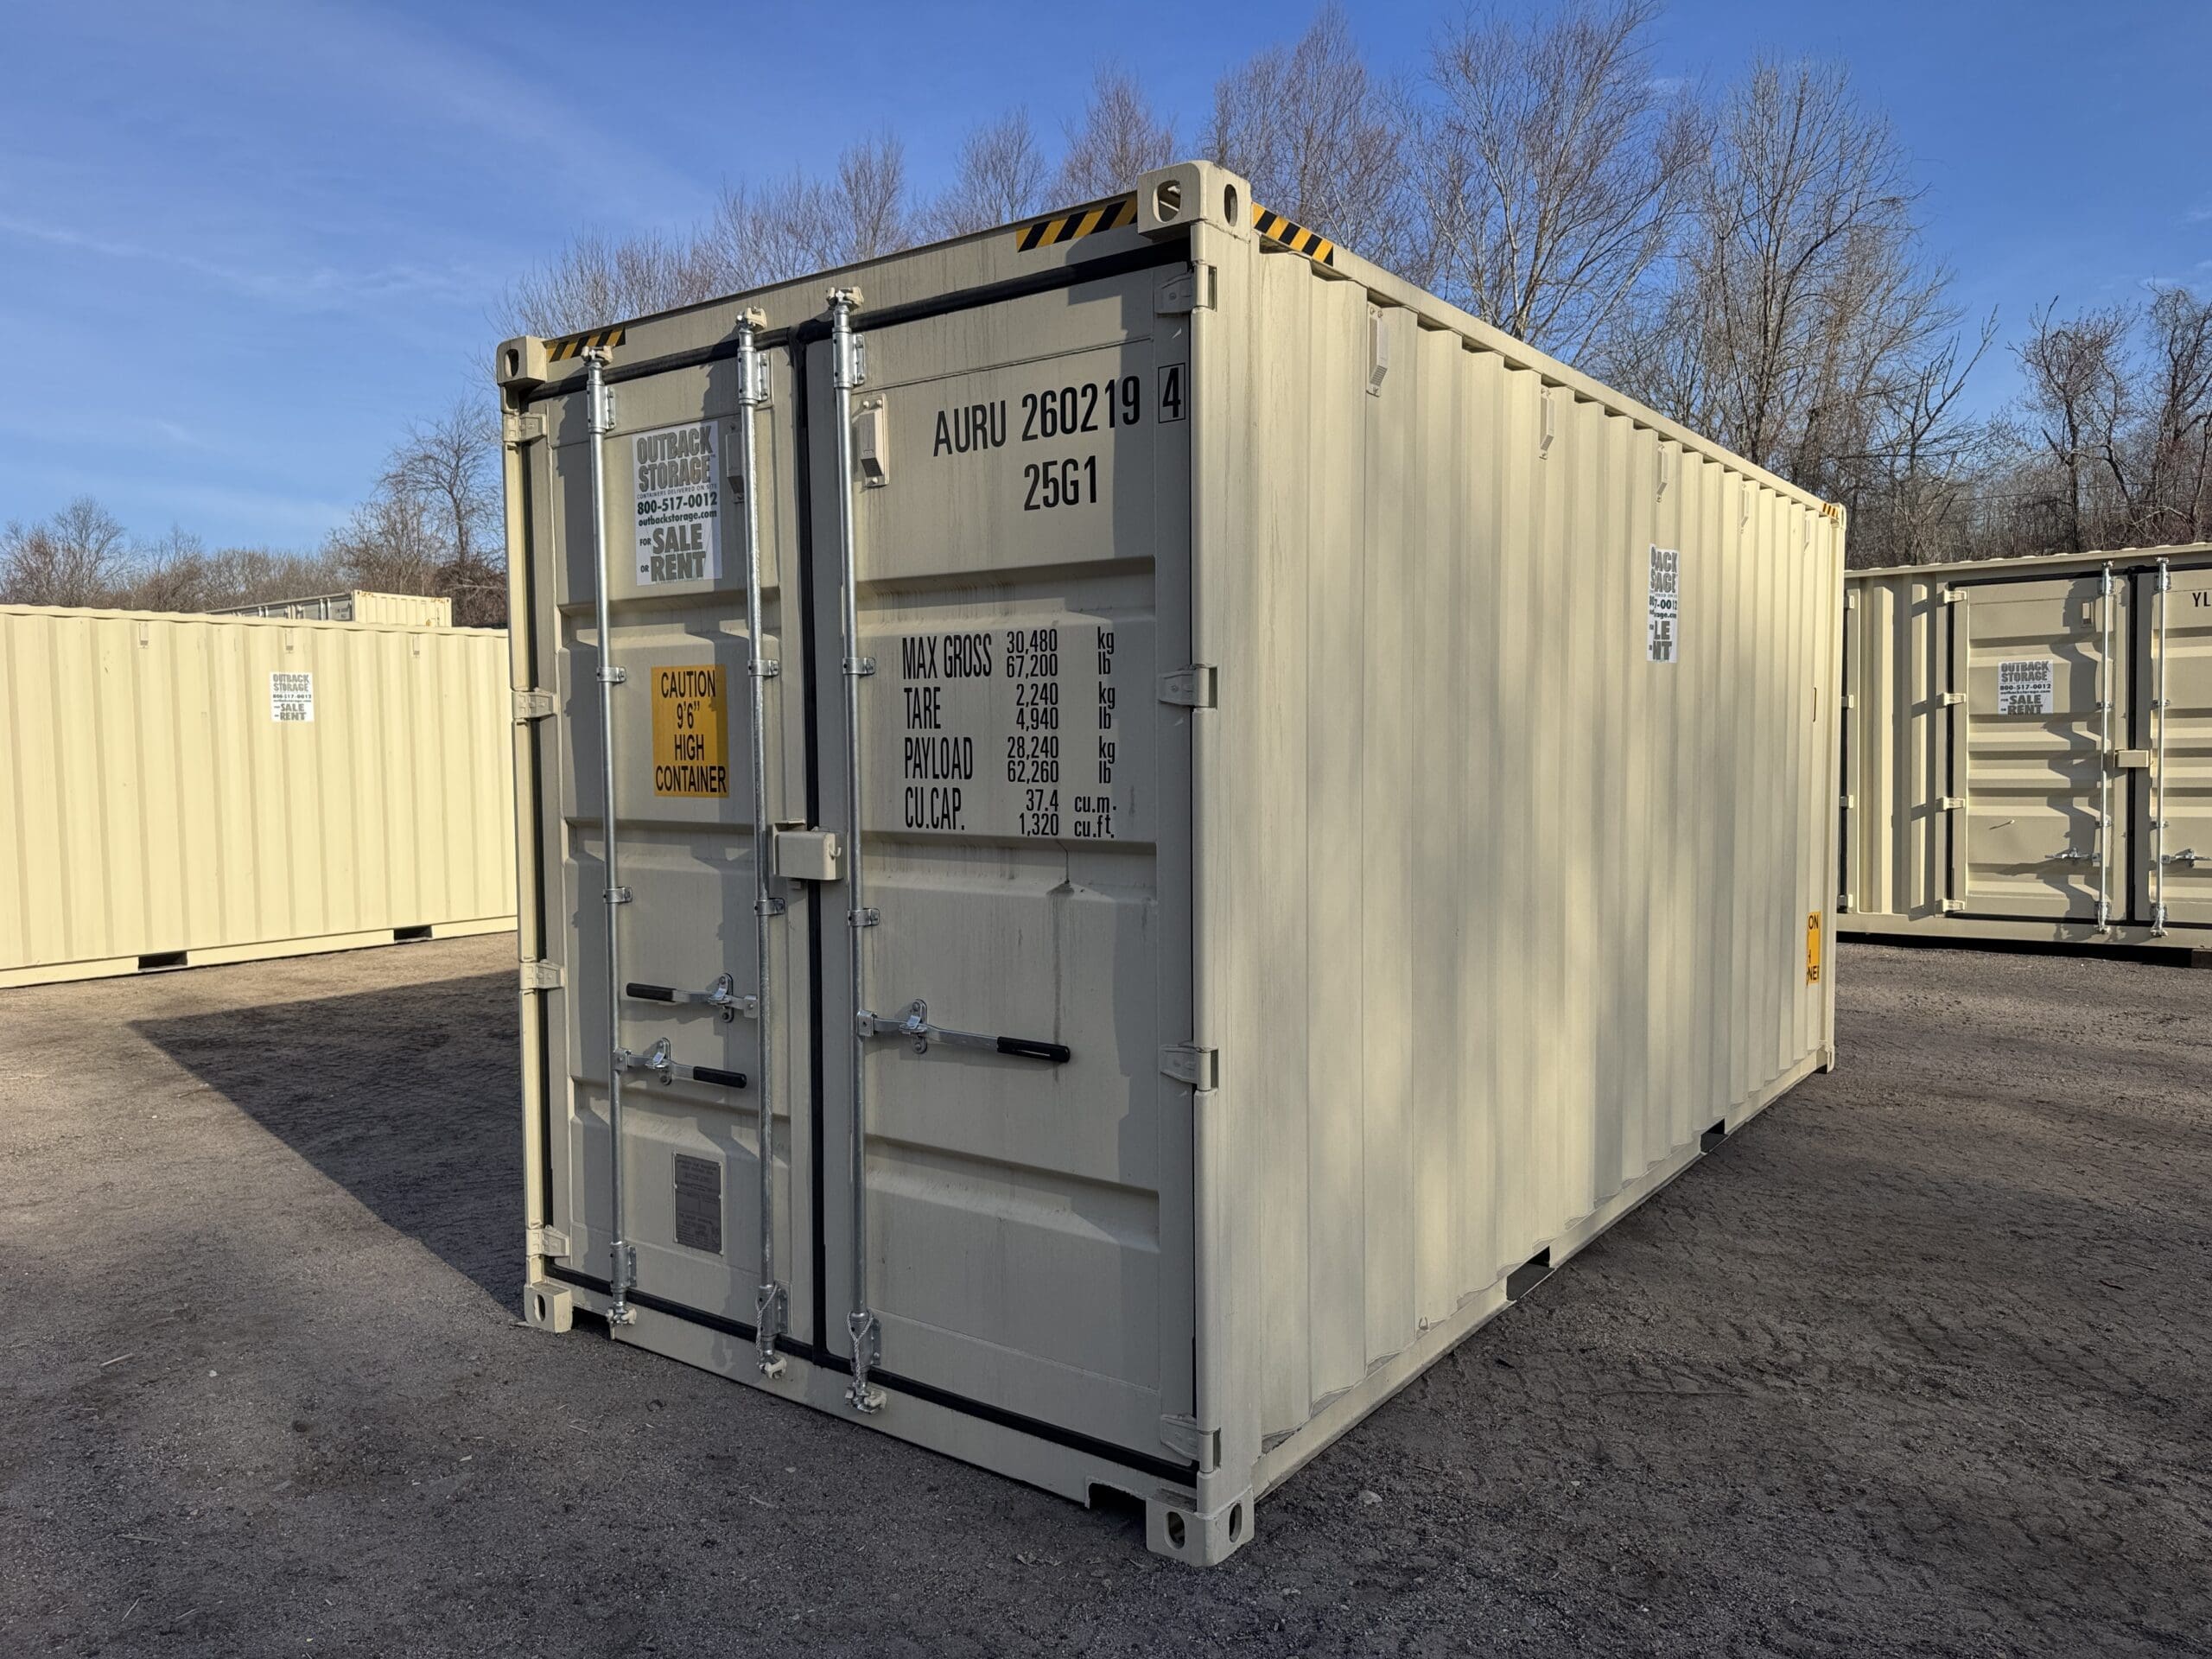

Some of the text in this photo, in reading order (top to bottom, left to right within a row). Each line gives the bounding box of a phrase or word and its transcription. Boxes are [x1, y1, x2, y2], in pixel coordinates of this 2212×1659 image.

[933, 367, 1182, 457] AURU 260219 4
[637, 426, 713, 464] OUTBACK
[639, 455, 711, 492] STORAGE
[1024, 455, 1096, 511] 25G1
[638, 492, 717, 515] 800-517-0012
[639, 511, 717, 526] outbackstorage.com
[652, 524, 702, 554] SALE
[651, 551, 706, 582] RENT
[1007, 626, 1115, 654] 30,480 kg
[902, 633, 992, 679] MAX GROSS
[1007, 652, 1111, 679] 67,200 lb
[2001, 661, 2049, 672] OUTBACK
[273, 674, 309, 683] OUTBACK
[273, 683, 308, 691] STORAGE
[661, 671, 715, 698] CAUTION
[2001, 671, 2048, 683] STORAGE
[904, 687, 941, 729] TARE
[1016, 681, 1116, 709] 2,240 kg
[2009, 695, 2041, 704] SALE
[280, 712, 306, 721] RENT
[1016, 706, 1111, 732] 4,940 lb
[2007, 704, 2043, 715] RENT
[674, 734, 704, 760] HIGH
[905, 737, 973, 779] PAYLOAD
[1007, 735, 1116, 764] 28,240 kg
[655, 766, 727, 793] CONTAINER
[1007, 760, 1111, 784] 62,260 lb
[905, 786, 965, 830] CU.CAP.
[1026, 789, 1058, 812] 37.4
[1019, 813, 1115, 838] 1,320 cu.ft.
